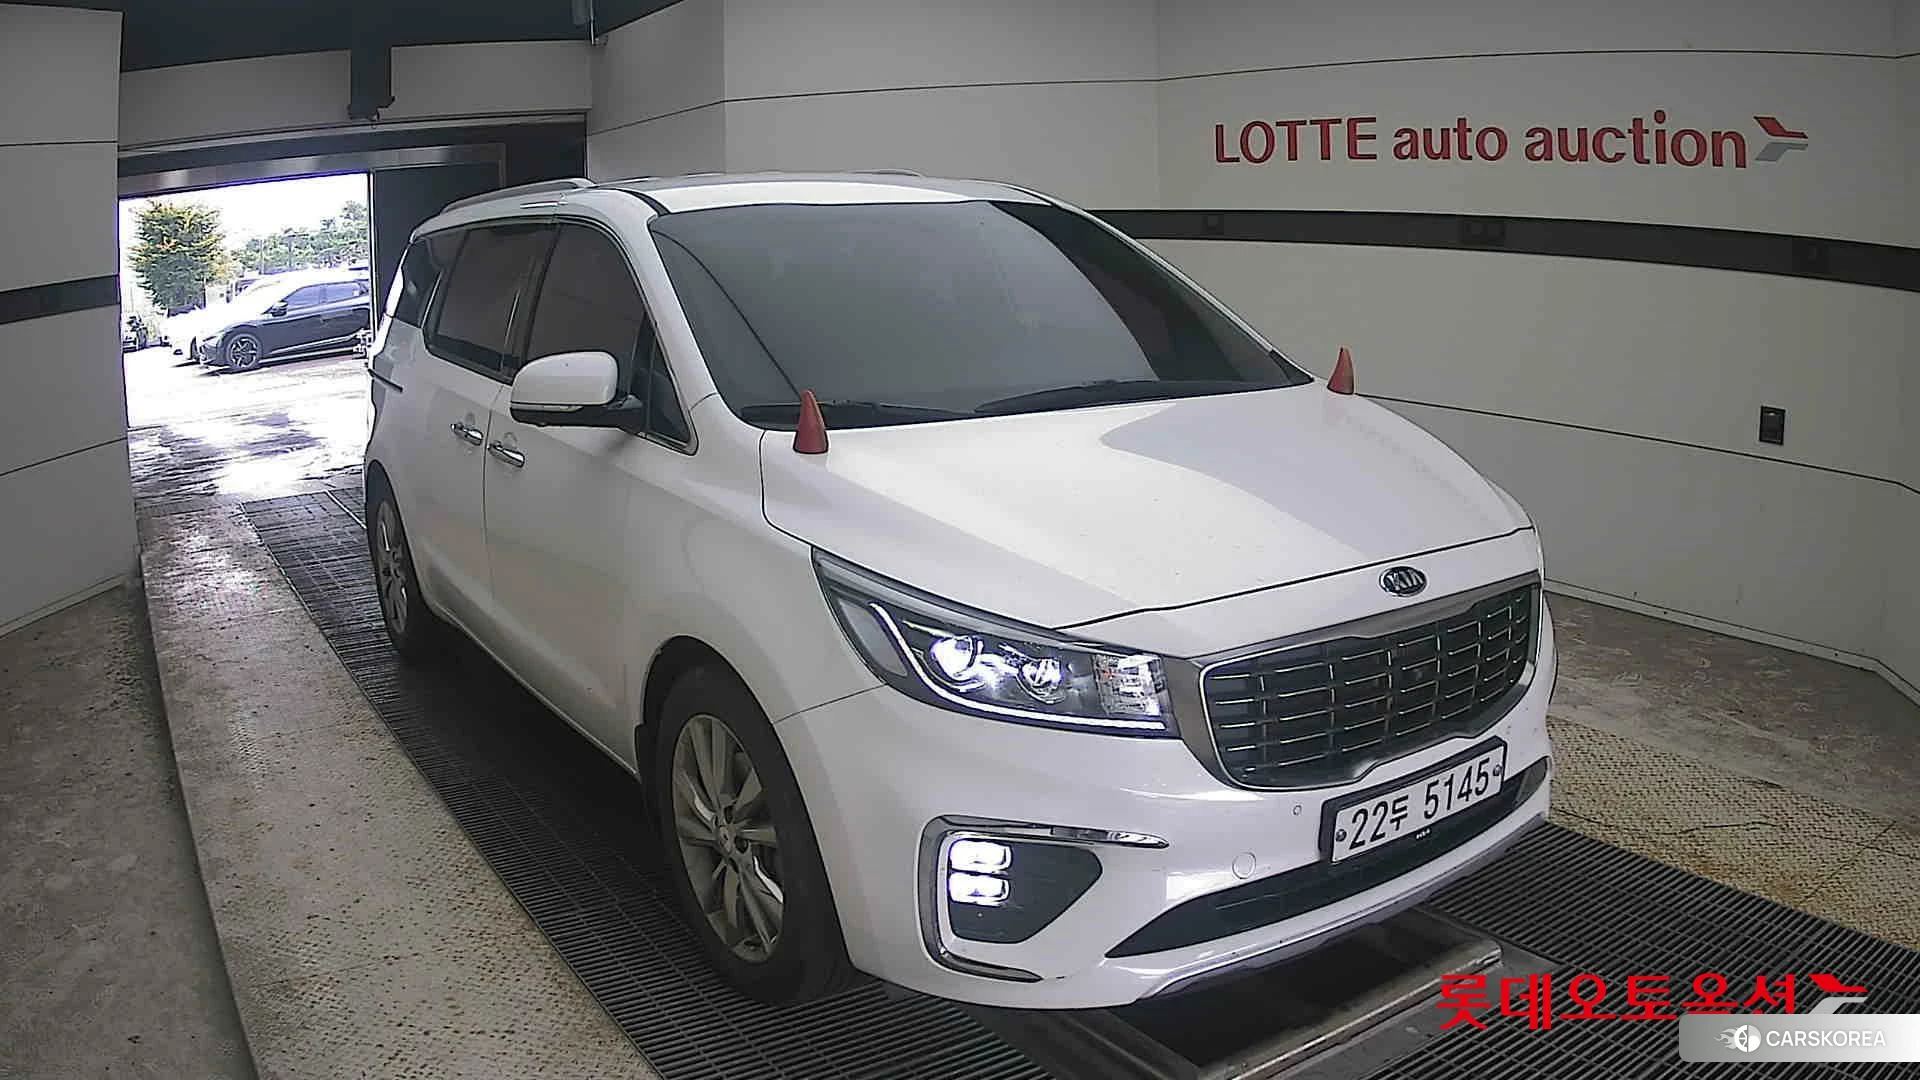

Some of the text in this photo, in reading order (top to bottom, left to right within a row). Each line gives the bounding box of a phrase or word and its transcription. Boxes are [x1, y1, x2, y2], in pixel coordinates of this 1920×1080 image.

[1214, 110, 1747, 169] LOTTE auto auction
[1349, 757, 1490, 850] 22두 5145
